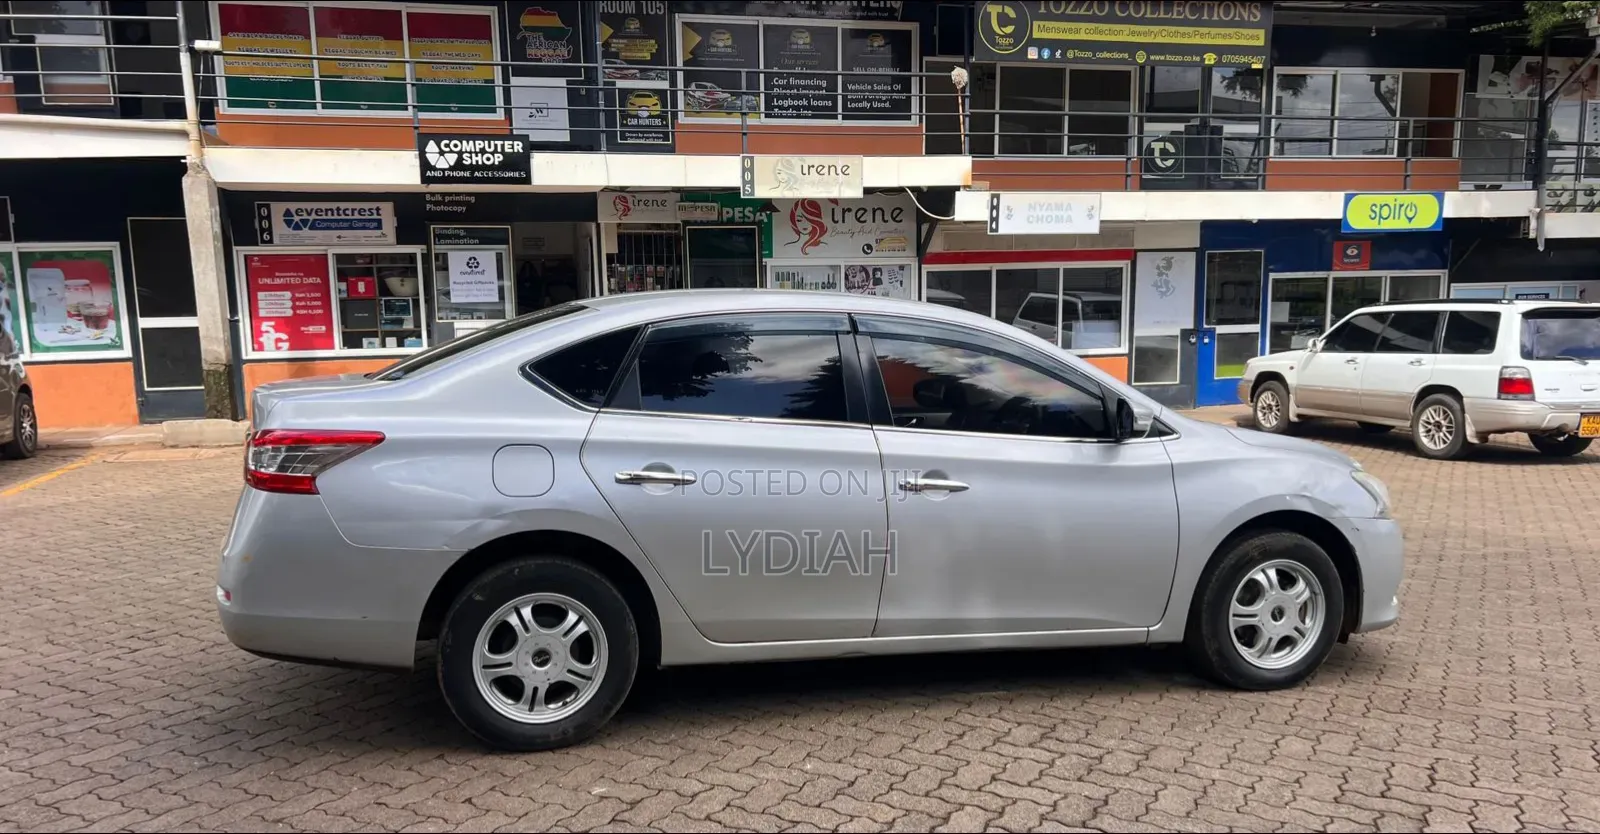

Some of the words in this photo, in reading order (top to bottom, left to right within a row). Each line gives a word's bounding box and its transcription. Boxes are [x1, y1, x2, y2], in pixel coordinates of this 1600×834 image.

[640, 1, 665, 15] 105
[1037, 1, 1109, 17] TOZZO
[1114, 1, 1262, 22] COLLECTIONS
[1037, 24, 1082, 34] Menswear
[526, 40, 567, 49] AFRICAN
[789, 76, 827, 88] financing
[847, 83, 872, 91] Vehicle
[873, 83, 892, 91] Sales
[893, 83, 902, 91] Of
[810, 97, 833, 107] loans
[847, 101, 871, 110] Locally
[627, 118, 638, 126] CAR
[639, 118, 662, 126] HUNTERS
[440, 140, 524, 153] COMPUTER
[462, 153, 504, 166] SHOP
[425, 170, 444, 178] AND
[800, 164, 851, 176] irene
[425, 193, 444, 202] Bulk
[444, 193, 476, 204] printing
[632, 198, 668, 208] irene
[294, 205, 383, 217] eventcrest
[425, 204, 467, 212] Photocopy
[1027, 202, 1074, 212] NYAMA
[1368, 198, 1418, 226] spiro
[831, 206, 905, 224] irene
[1026, 213, 1074, 225] CHOMA
[315, 221, 351, 229] Computer
[351, 220, 379, 229] Garage
[435, 237, 480, 245] Lamination
